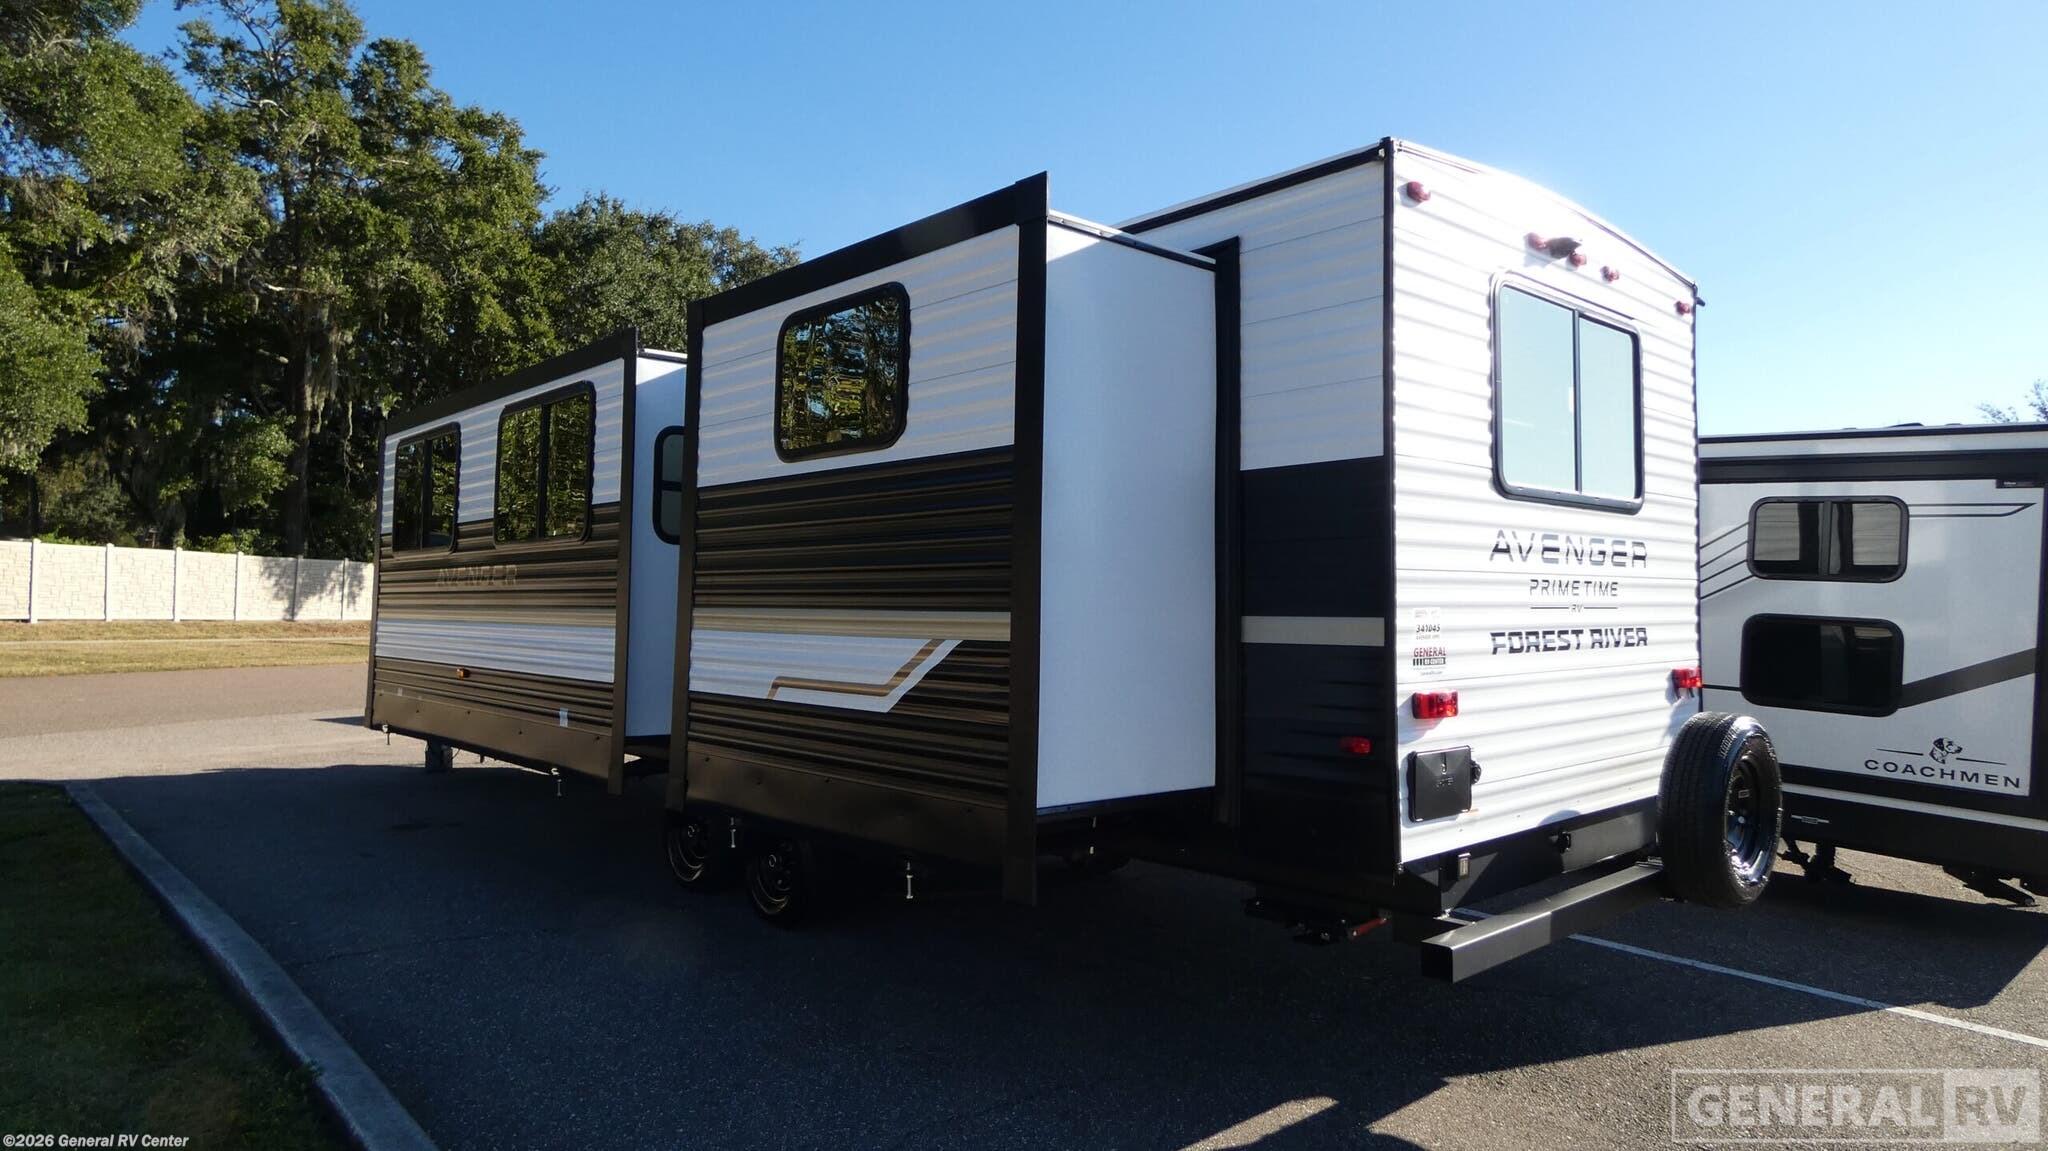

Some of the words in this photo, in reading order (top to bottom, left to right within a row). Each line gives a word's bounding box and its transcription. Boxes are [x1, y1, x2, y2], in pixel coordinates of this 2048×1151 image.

[1489, 529, 1647, 568] AVENGER
[435, 565, 518, 587] AVENGER
[1571, 604, 1583, 613] RV
[1413, 646, 1447, 658] GENERAL
[1489, 628, 1584, 655] FOREST
[1589, 627, 1648, 649] RIVER
[1864, 758, 2020, 789] COACHMEN
